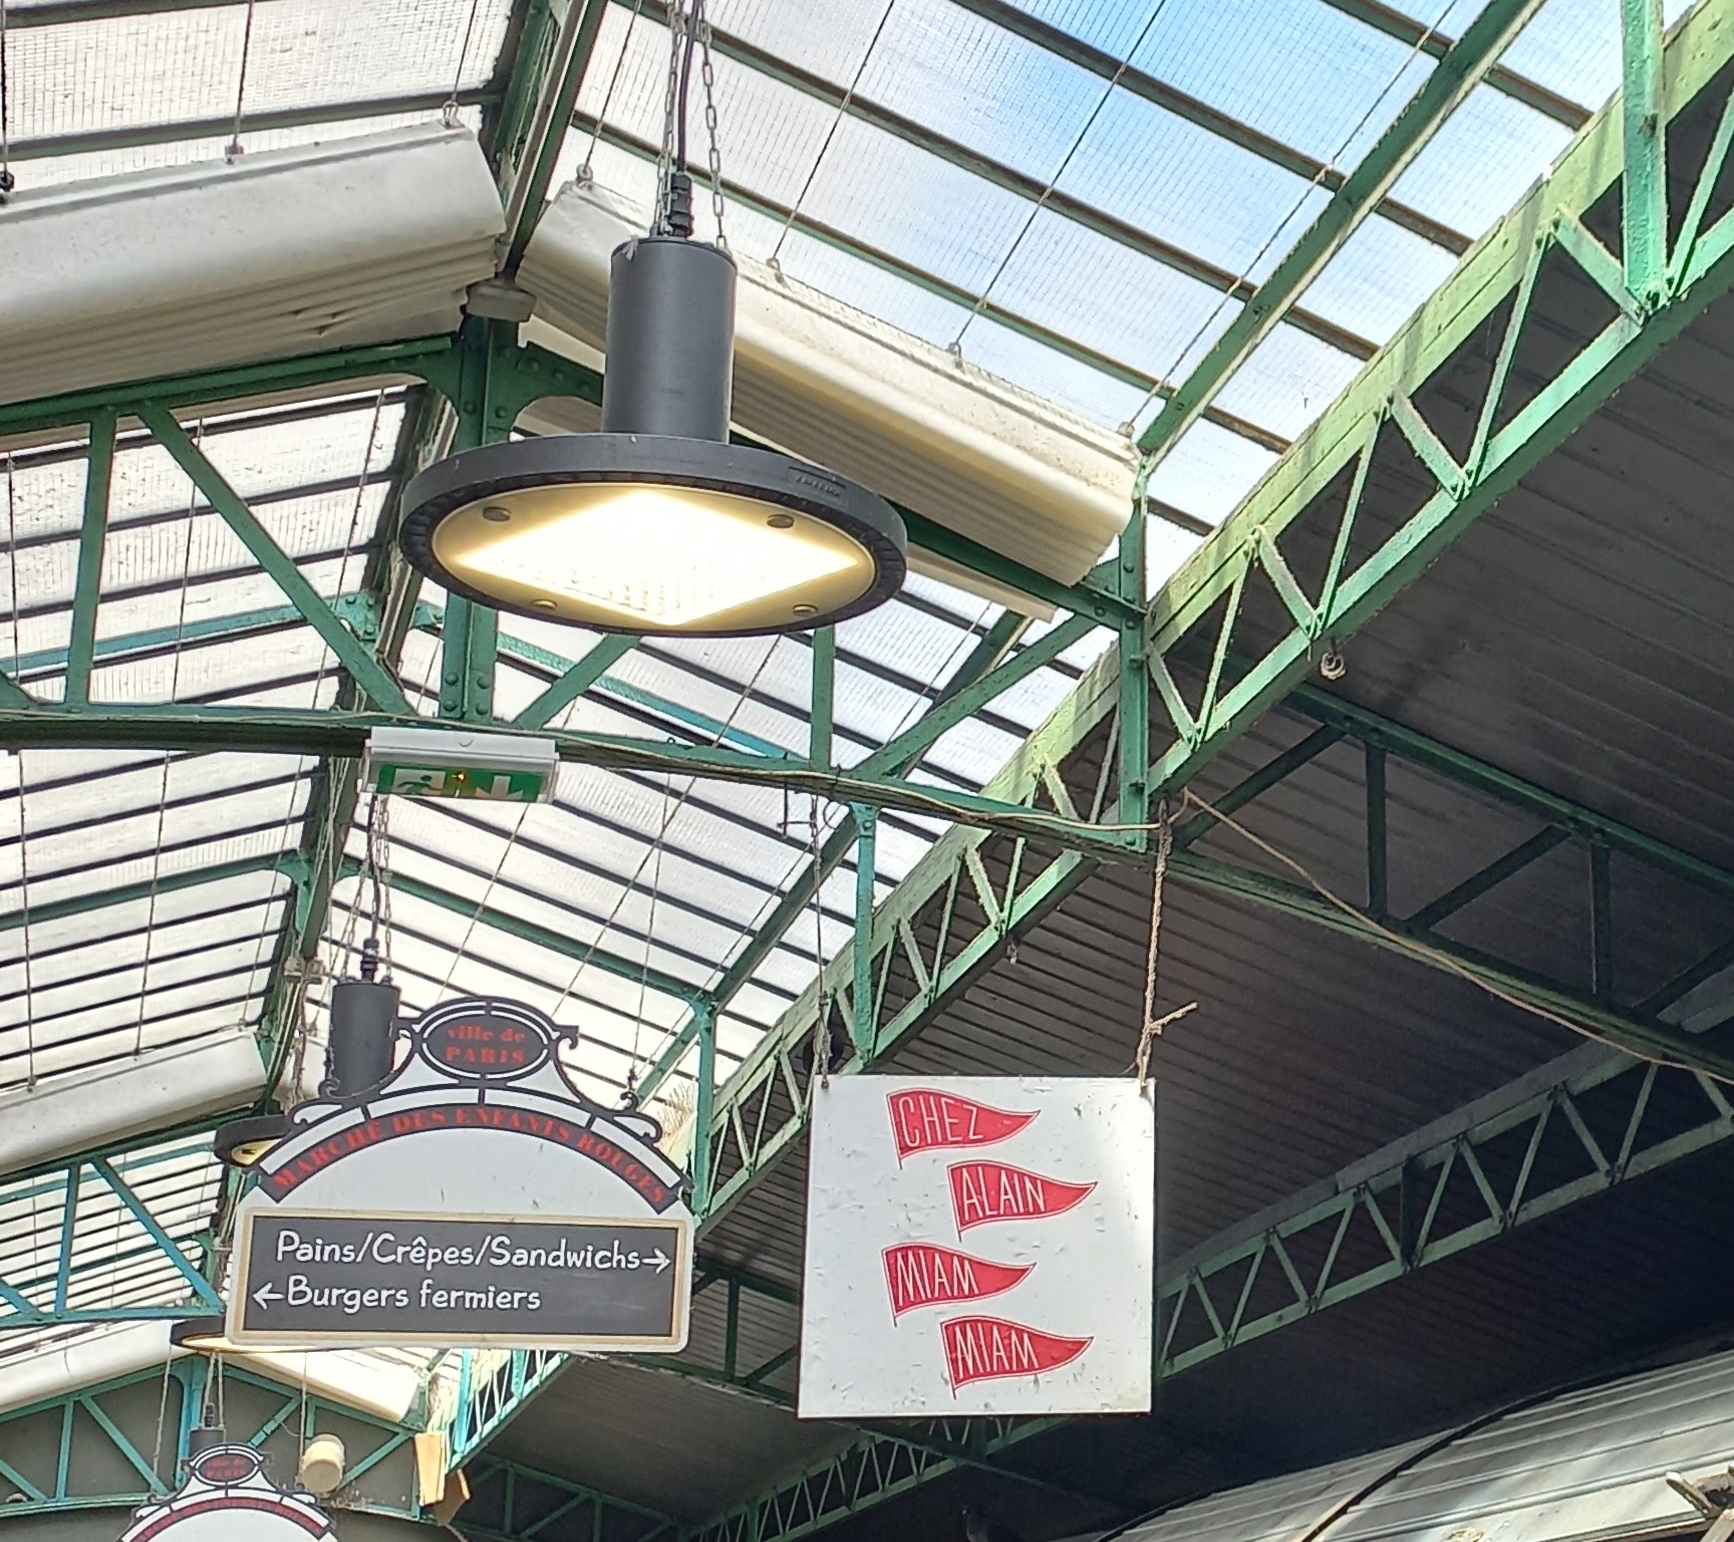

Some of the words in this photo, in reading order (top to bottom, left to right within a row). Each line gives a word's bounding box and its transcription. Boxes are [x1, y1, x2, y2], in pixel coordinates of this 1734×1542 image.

[446, 1045, 525, 1065] PARIS
[448, 1025, 494, 1042] ville
[500, 1027, 525, 1043] de
[898, 1096, 984, 1148] CHEZ
[392, 1110, 446, 1133] DES
[455, 1107, 571, 1142] ENFANTS
[577, 1131, 665, 1203] ROUGES
[961, 1165, 1047, 1222] ALAIN
[275, 1230, 641, 1272] Pains/Crêpes/Sandwichs
[287, 1274, 409, 1314] Burgers
[419, 1278, 542, 1311] fermiers
[895, 1250, 980, 1307] MIAM
[954, 1322, 1040, 1380] MIAM
